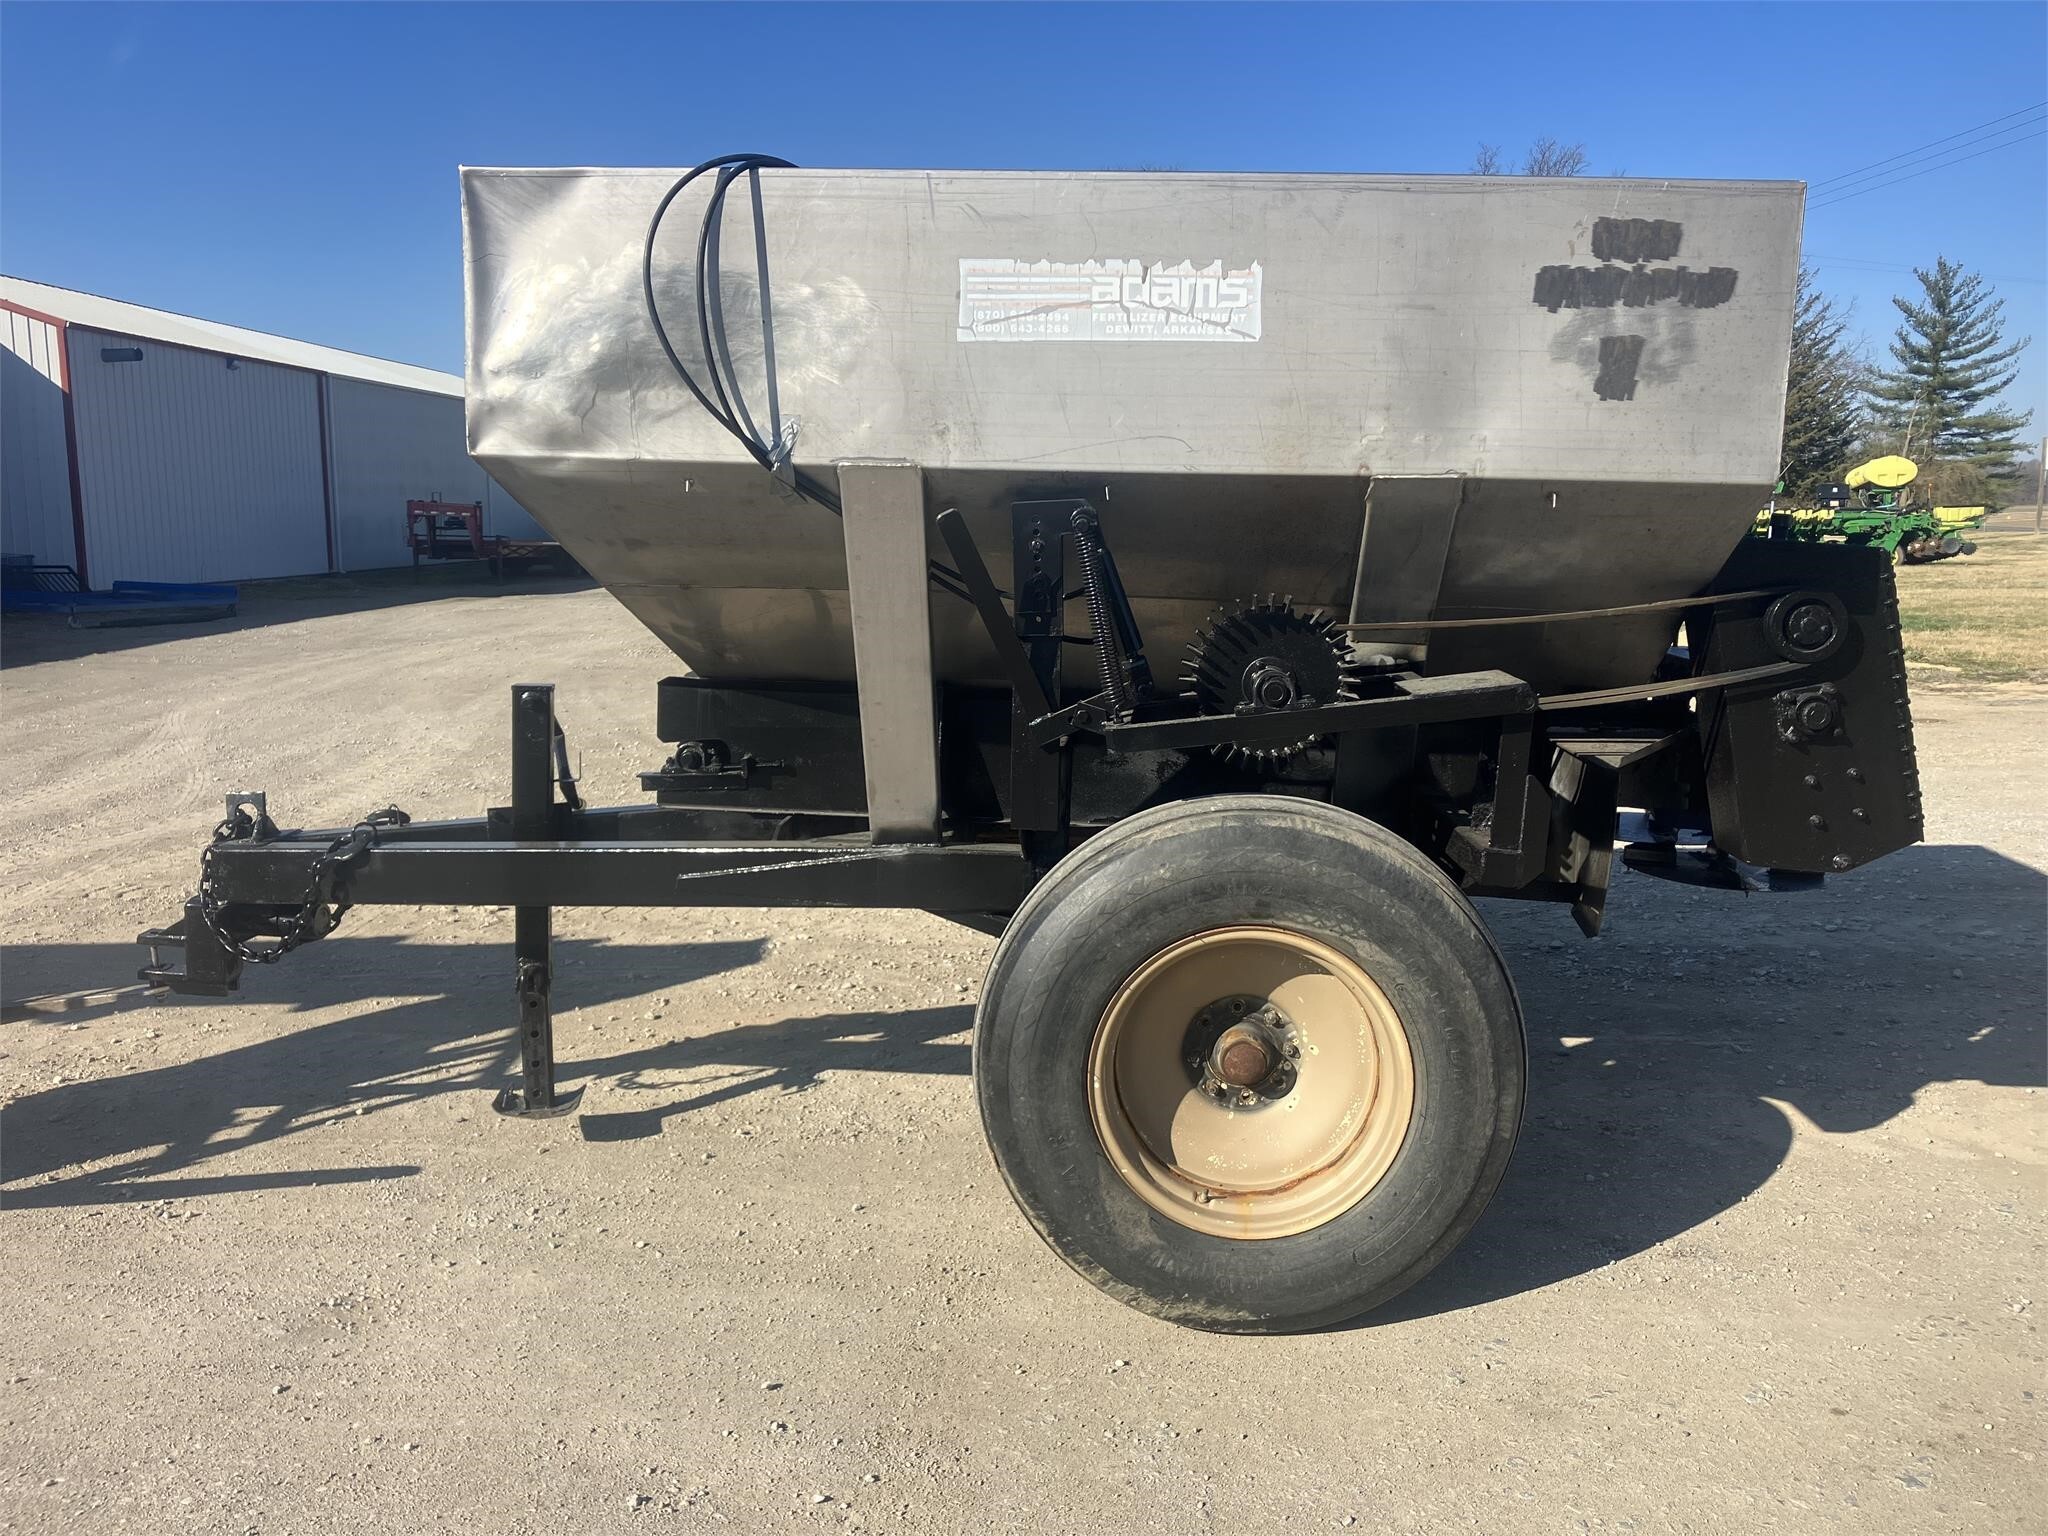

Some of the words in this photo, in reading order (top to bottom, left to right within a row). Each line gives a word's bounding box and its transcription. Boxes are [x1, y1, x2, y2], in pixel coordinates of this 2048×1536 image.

[1090, 271, 1248, 309] adams
[973, 309, 1005, 320] (870)
[1091, 312, 1165, 323] FERTILIZER
[1170, 312, 1248, 323] EQUIPMENT
[1162, 325, 1233, 336] ARKANSAS
